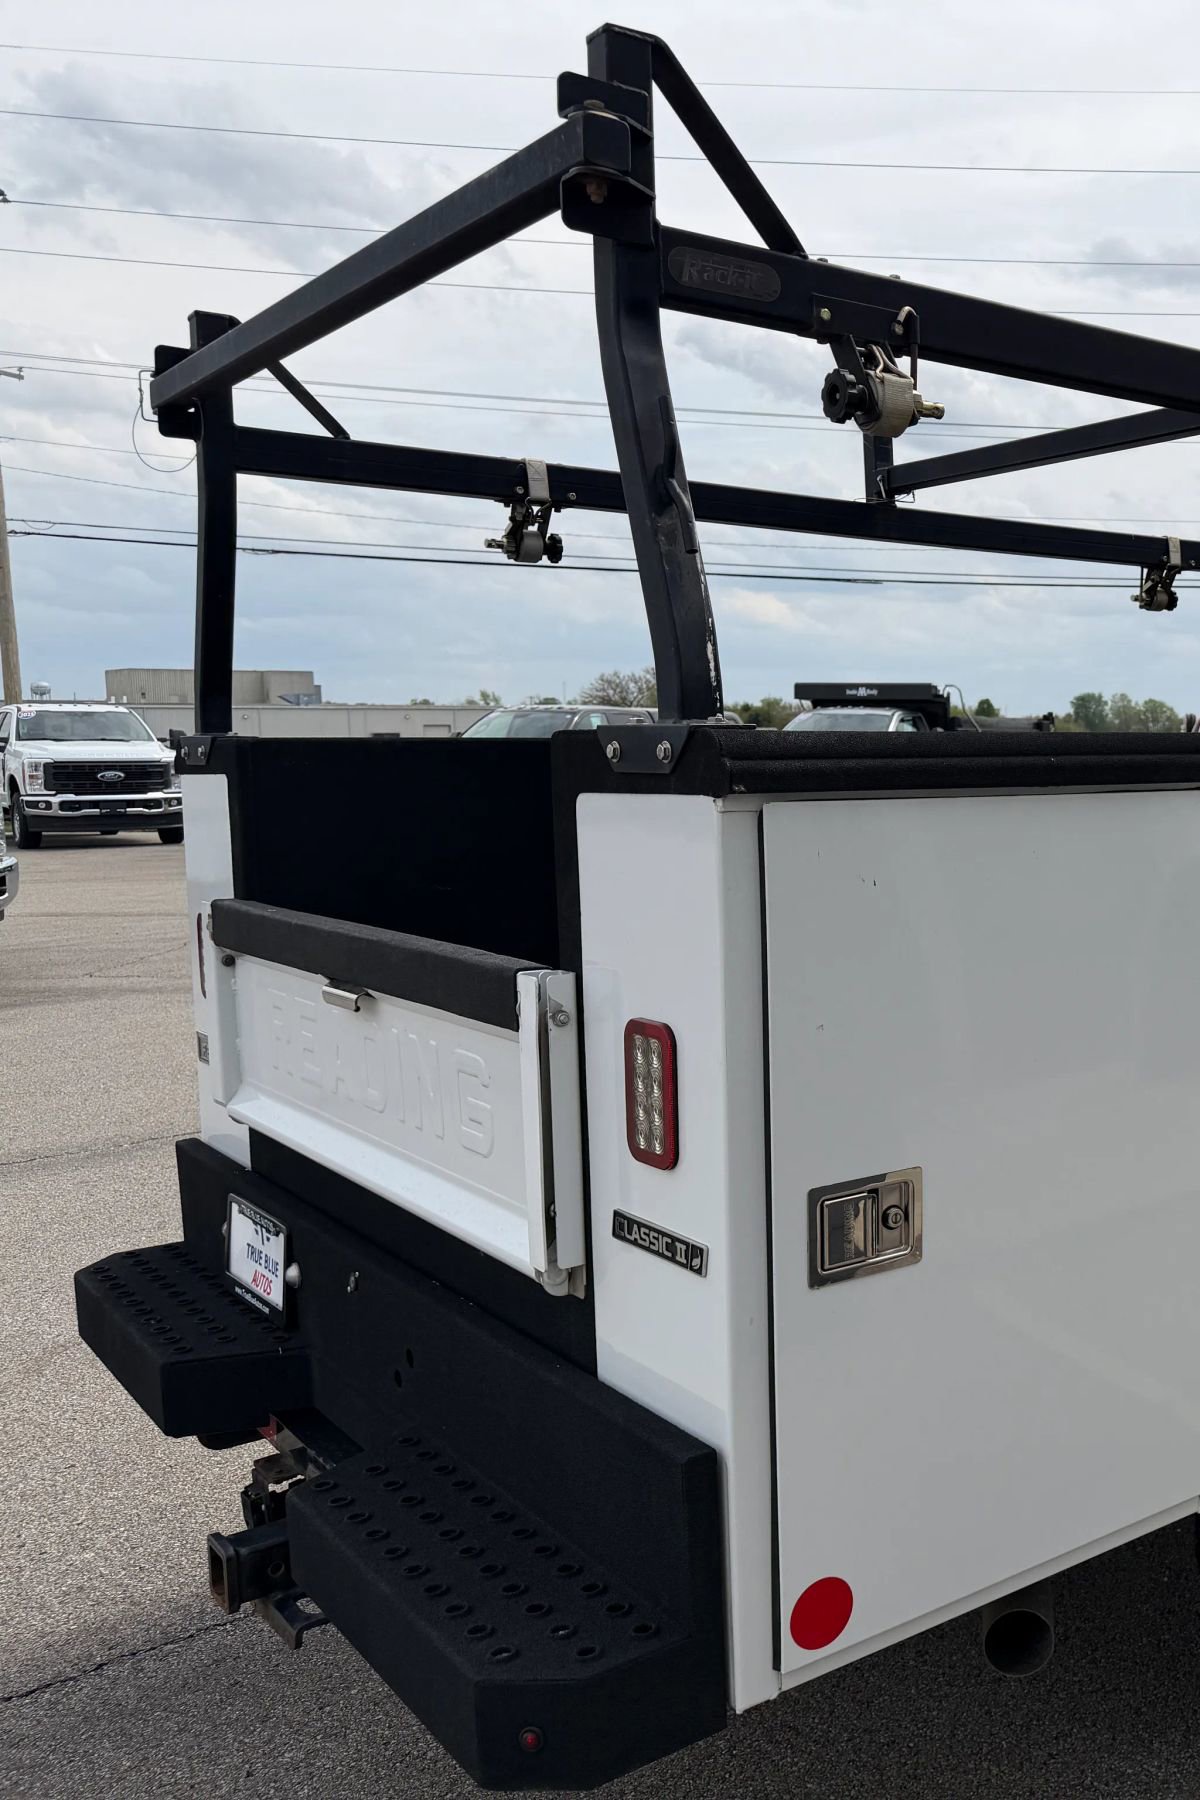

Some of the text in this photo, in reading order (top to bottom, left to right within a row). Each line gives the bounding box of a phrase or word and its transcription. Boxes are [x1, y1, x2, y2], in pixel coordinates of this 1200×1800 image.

[615, 1217, 687, 1264] CLASSIC II
[246, 1243, 279, 1278] TRUE BLUE
[251, 1269, 273, 1296] AUTOS
